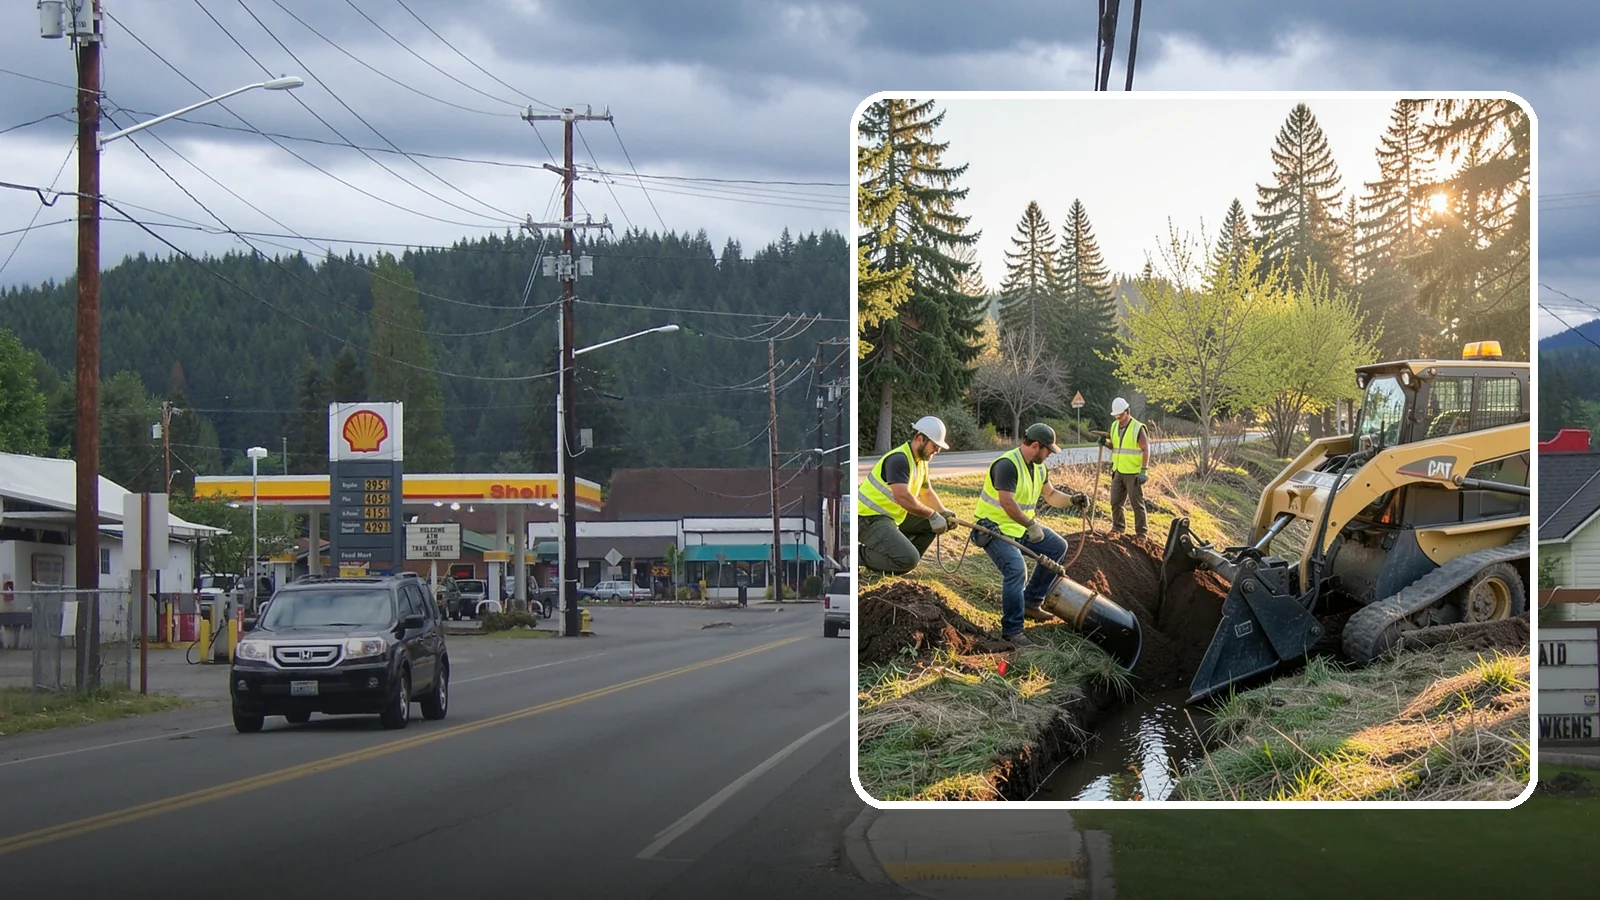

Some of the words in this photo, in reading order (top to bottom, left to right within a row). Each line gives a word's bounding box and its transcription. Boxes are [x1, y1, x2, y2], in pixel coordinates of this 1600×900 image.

[1428, 460, 1452, 479] CAT
[365, 480, 383, 490] 395
[490, 484, 547, 499] Shell
[365, 494, 383, 504] 405
[365, 508, 383, 518] 415
[365, 522, 383, 532] 429
